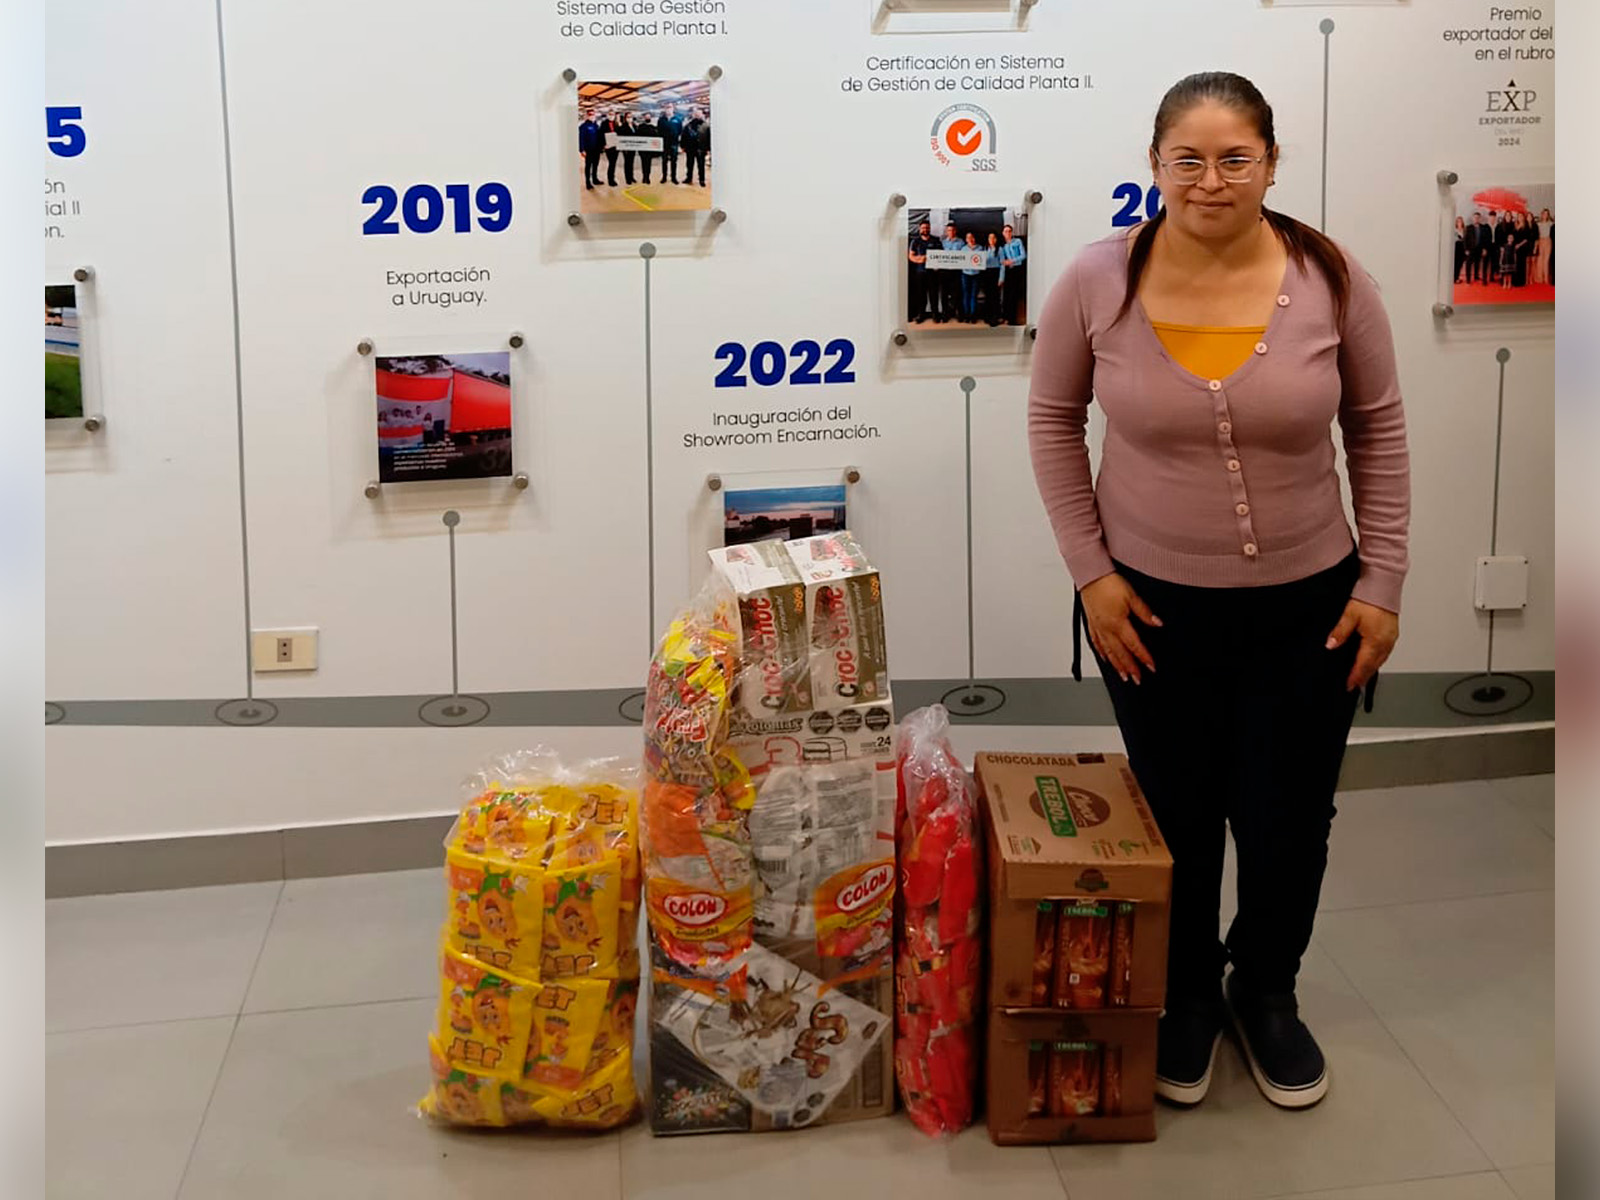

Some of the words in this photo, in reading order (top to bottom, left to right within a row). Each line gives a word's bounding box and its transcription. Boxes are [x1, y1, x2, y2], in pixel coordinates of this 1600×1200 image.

[557, 0, 626, 16] Sistema
[632, 0, 655, 15] de
[660, 0, 726, 15] Gestión
[1490, 7, 1542, 22] Premio
[560, 22, 585, 37] de
[589, 20, 658, 37] Calidad
[663, 20, 717, 36] Planta
[721, 20, 729, 36] I.
[1443, 26, 1526, 45] exportador
[1529, 26, 1554, 41] del
[866, 55, 971, 72] Certificación
[975, 57, 996, 70] en
[1000, 54, 1065, 70] Sistema
[1475, 48, 1495, 61] en
[1498, 46, 1512, 61] el
[1515, 46, 1555, 61] rubro
[841, 76, 863, 93] de
[867, 75, 930, 92] Gestión
[934, 75, 957, 91] de
[960, 75, 1025, 91] Calidad
[1029, 75, 1080, 91] Planta
[1083, 75, 1095, 90] II.
[1485, 90, 1538, 113] EXP
[1478, 115, 1542, 126] EXPORTADOR
[46, 106, 86, 158] 5
[971, 158, 997, 172] SGS
[361, 181, 513, 236] 2019
[386, 266, 491, 288] Exportación
[391, 294, 405, 307] a
[409, 290, 488, 308] Uruguay.
[714, 338, 856, 388] 2022
[713, 407, 822, 428] Inauguración
[827, 405, 852, 420] del
[683, 430, 772, 448] Showroom
[777, 423, 881, 444] Encarnación.
[877, 736, 891, 748] 24
[986, 754, 1078, 768] CHOCOLATADA
[579, 793, 629, 825] JET
[841, 867, 888, 908] COLON
[669, 898, 717, 918] COLON
[447, 1037, 502, 1069] JET
